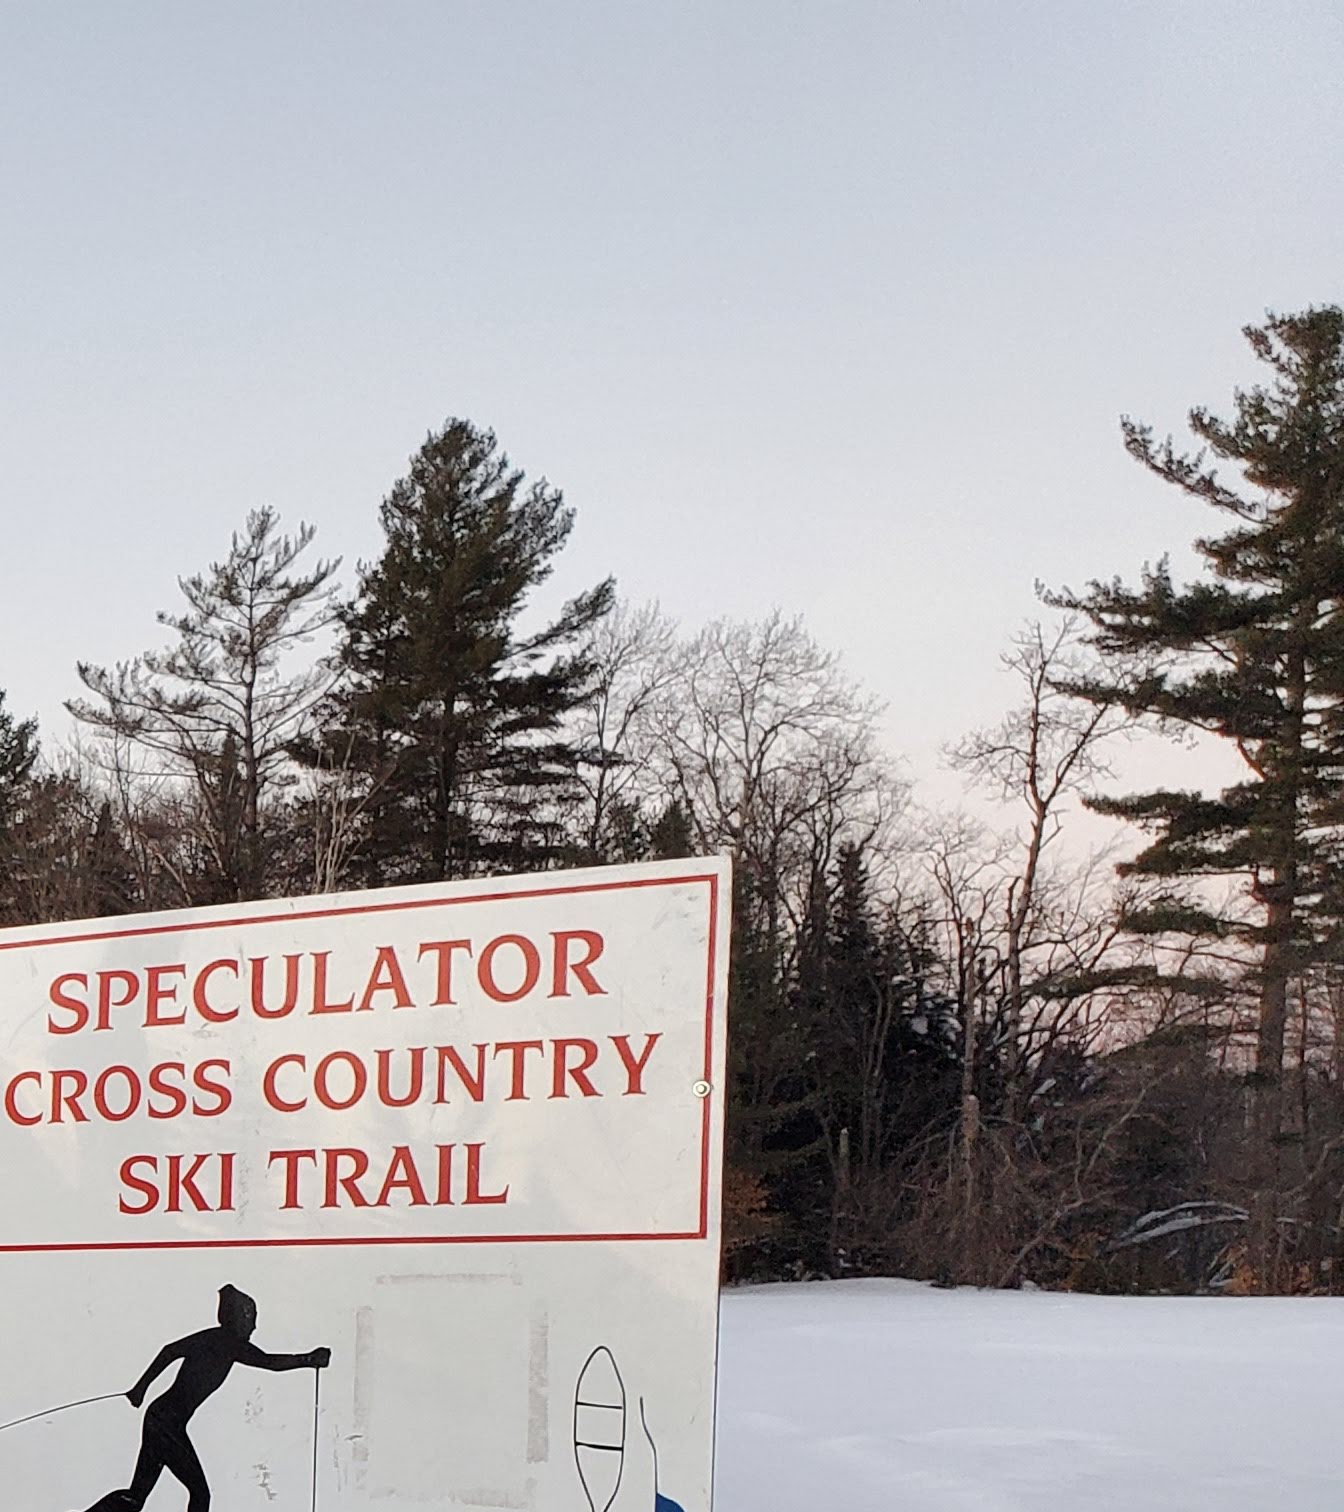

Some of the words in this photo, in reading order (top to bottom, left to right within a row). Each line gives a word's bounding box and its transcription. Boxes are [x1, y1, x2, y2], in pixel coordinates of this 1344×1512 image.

[46, 929, 609, 1036] SPECULATOR
[3, 1058, 233, 1127] CROSS
[262, 1032, 664, 1114] COUNTRY
[117, 1151, 237, 1216] SKI
[267, 1142, 510, 1211] TRAIL
